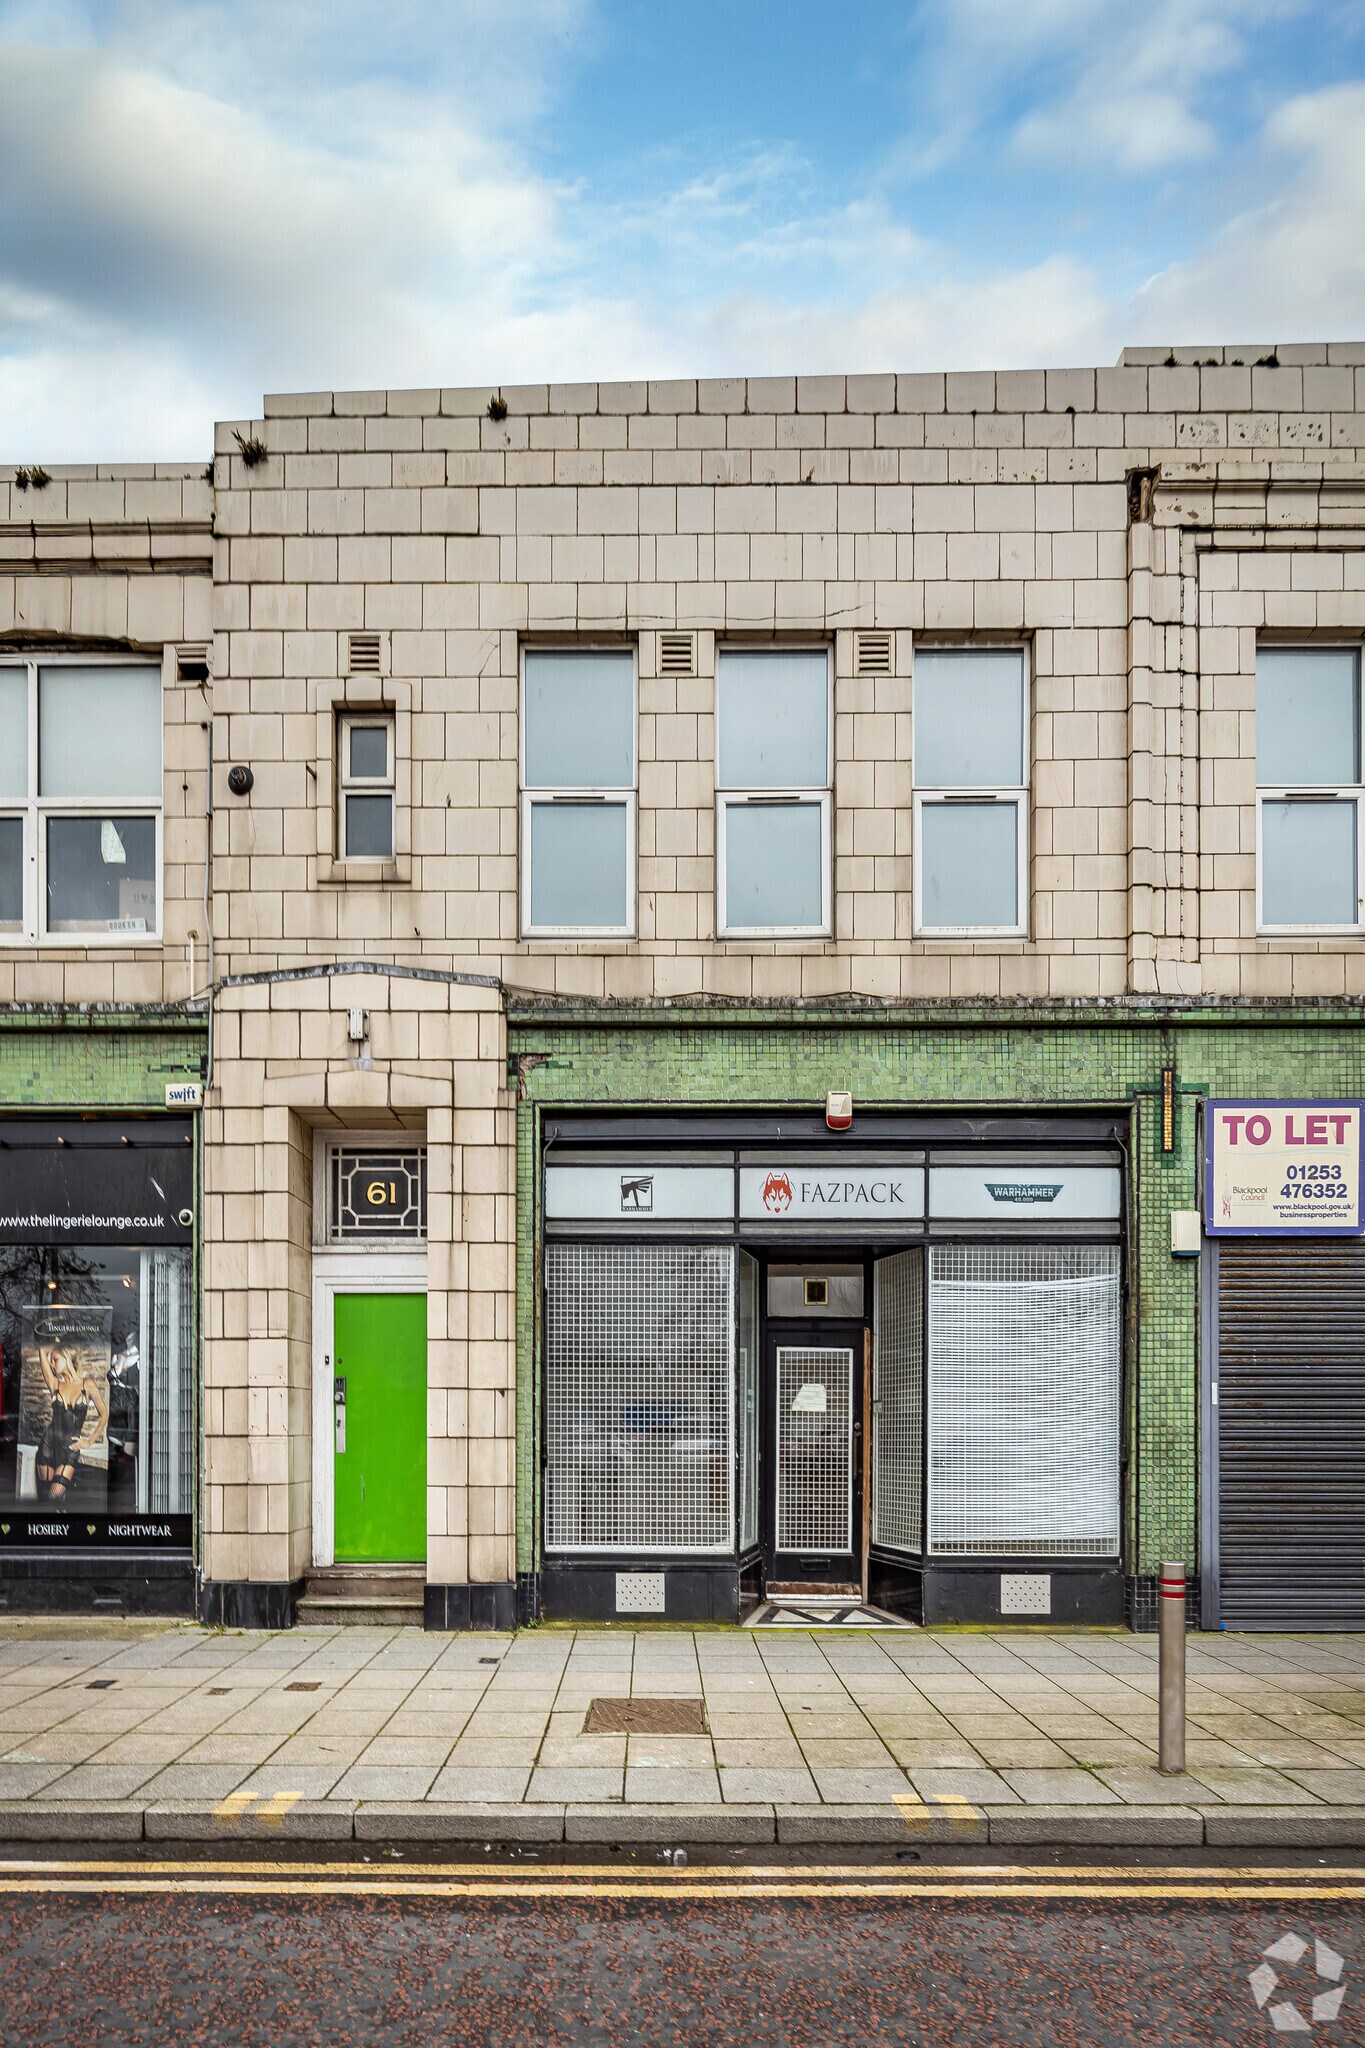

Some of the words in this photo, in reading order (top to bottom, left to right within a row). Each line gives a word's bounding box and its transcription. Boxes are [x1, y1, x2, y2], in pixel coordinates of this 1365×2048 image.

[169, 1086, 196, 1103] swift
[1222, 1115, 1271, 1145] TO
[1285, 1115, 1352, 1145] LET
[1286, 1164, 1342, 1180] 01253
[367, 1181, 396, 1205] 61
[801, 1182, 904, 1203] FAZPACK
[994, 1187, 1054, 1197] WARHAMMER
[1232, 1186, 1268, 1195] Blackpool
[1280, 1183, 1348, 1199] 476352
[1272, 1203, 1355, 1211] www.blackpool.gov.uk/
[1280, 1211, 1348, 1219] businessproperties
[28, 1524, 69, 1536] HOSIERY
[108, 1524, 172, 1537] NIGHTWEAR
